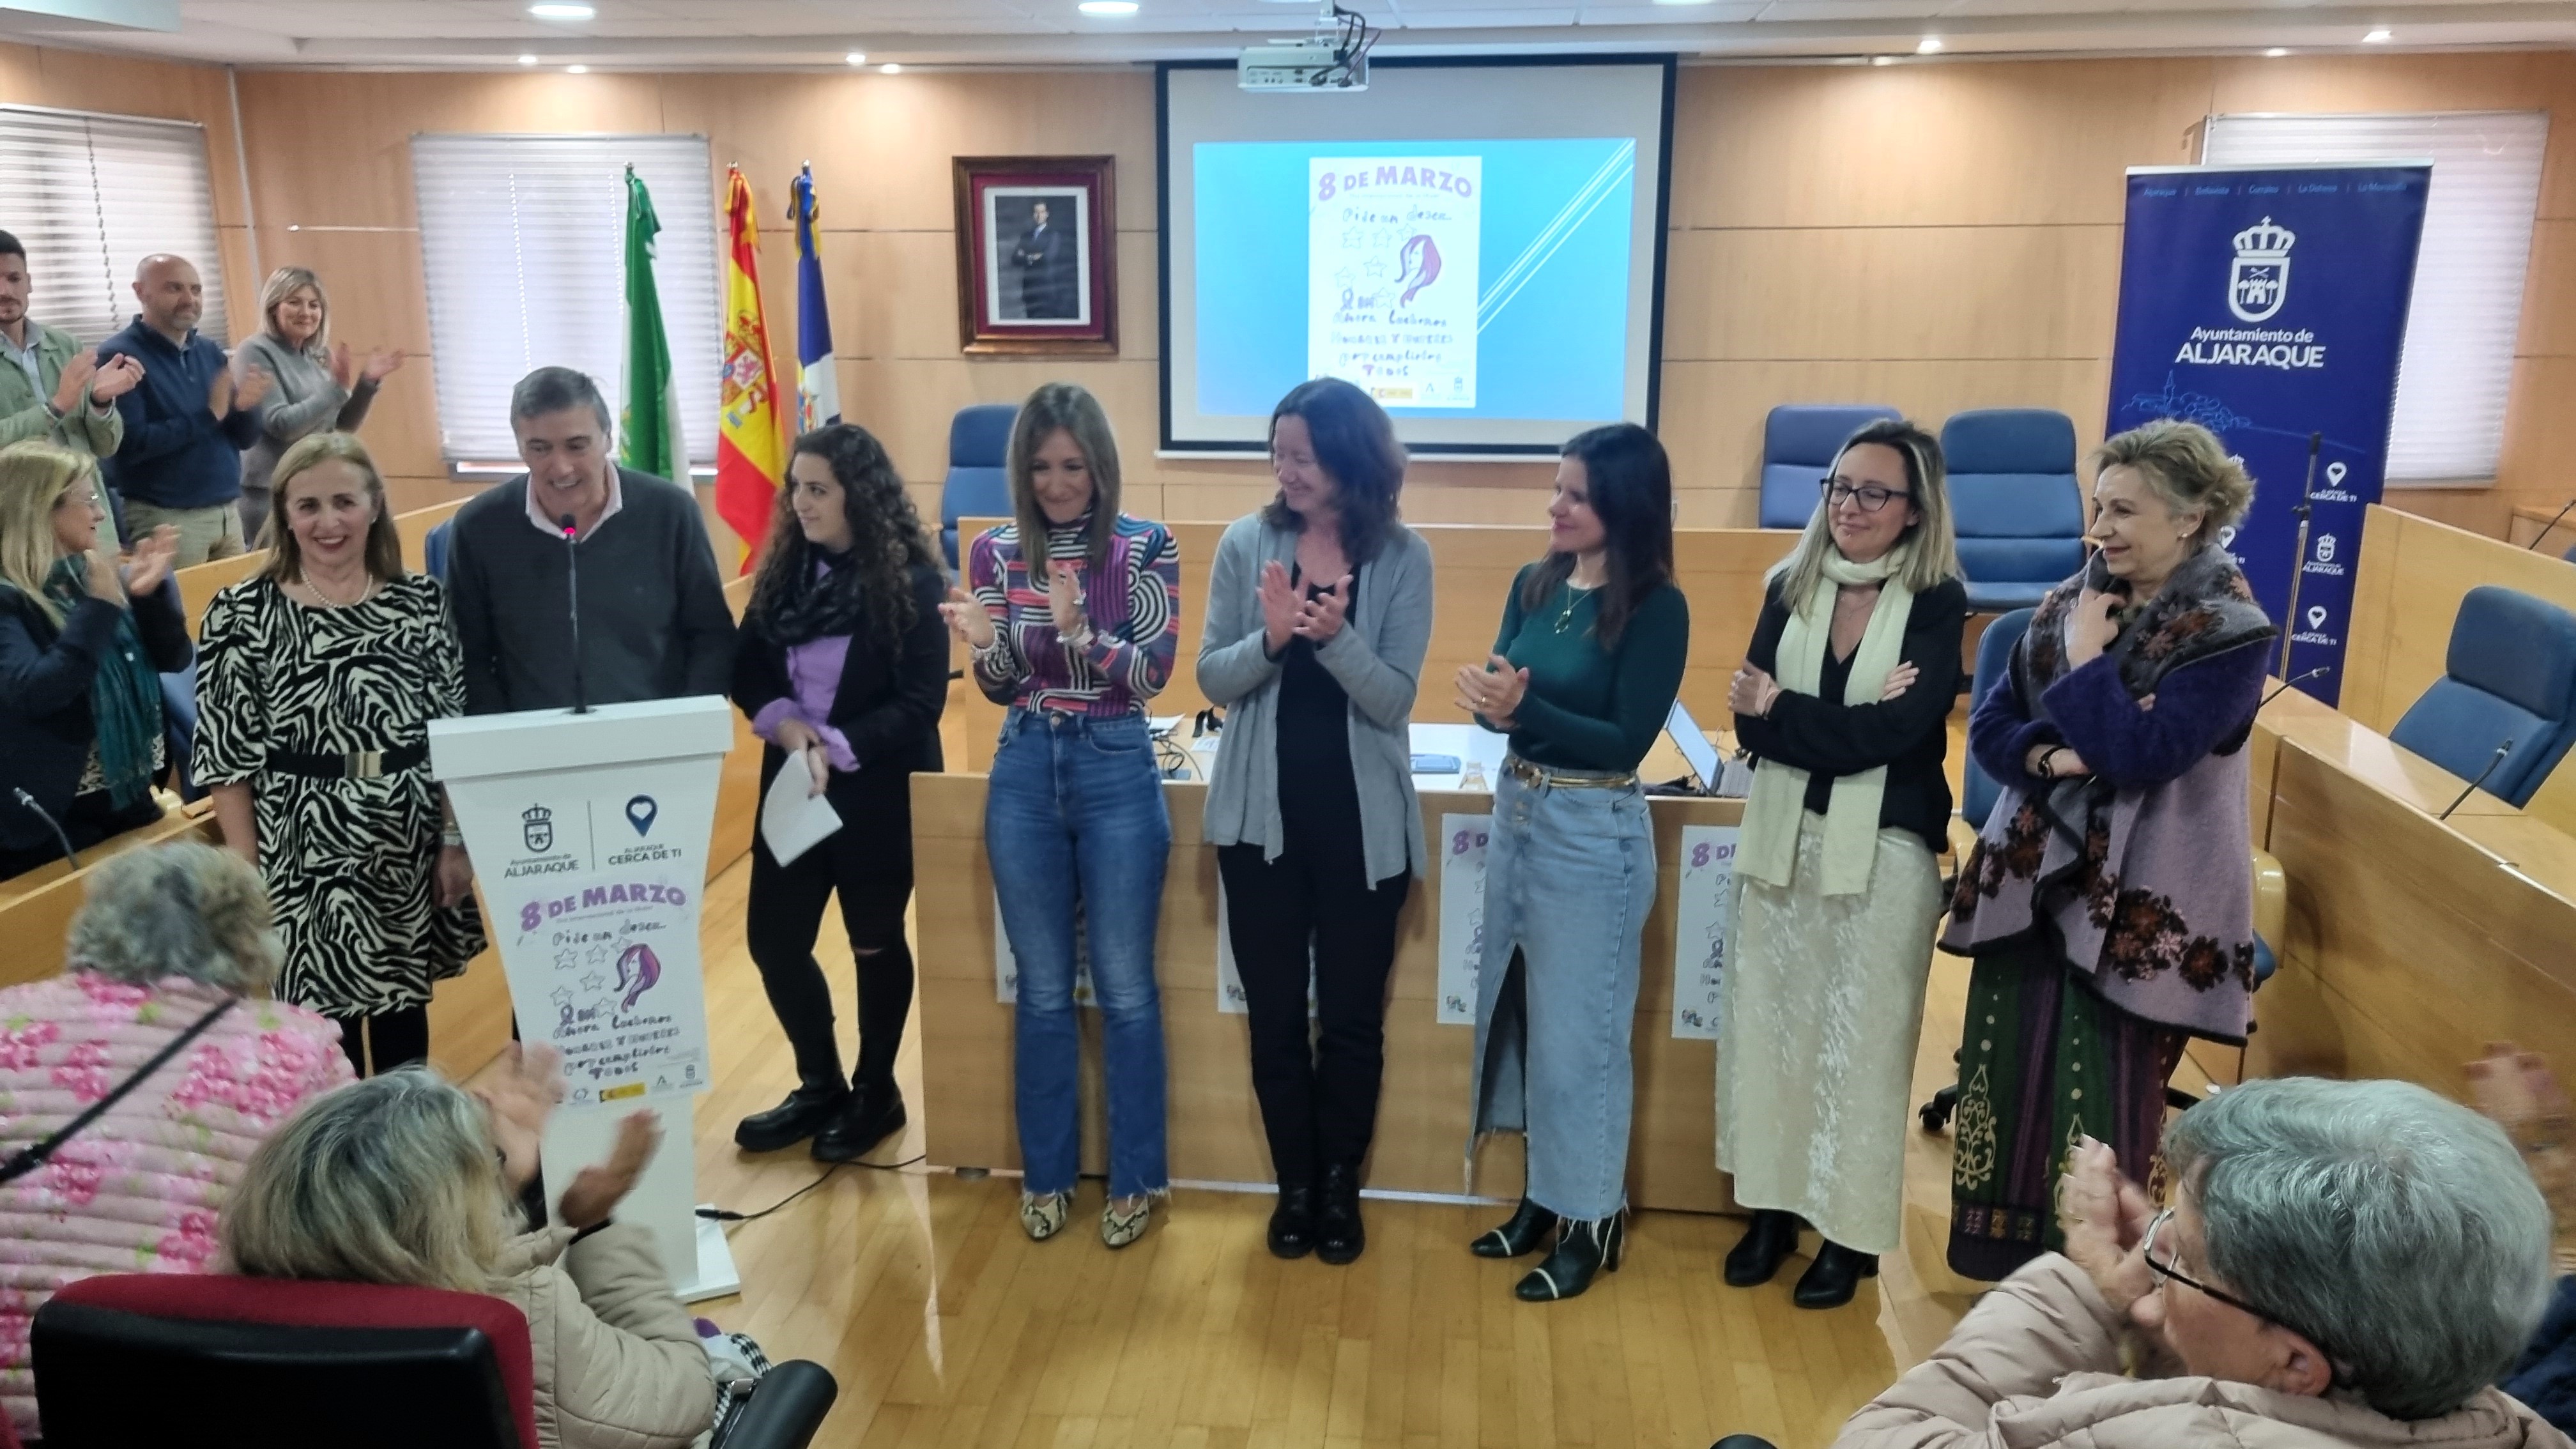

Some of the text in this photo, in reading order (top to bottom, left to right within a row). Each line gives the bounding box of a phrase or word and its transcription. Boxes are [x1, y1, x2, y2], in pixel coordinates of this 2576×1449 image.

[1318, 165, 1472, 202] 8 DE MARZO
[2190, 326, 2314, 343] Ayuntamiento de
[2174, 342, 2327, 370] ALJARAQUE
[1452, 831, 1489, 855] 8 D
[1691, 842, 1710, 867] 8
[504, 859, 579, 879] ALJARAQUE
[609, 848, 682, 866] CERCA DE TI
[521, 901, 541, 931] 8
[548, 896, 576, 919] DE
[582, 883, 687, 909] MARZO
